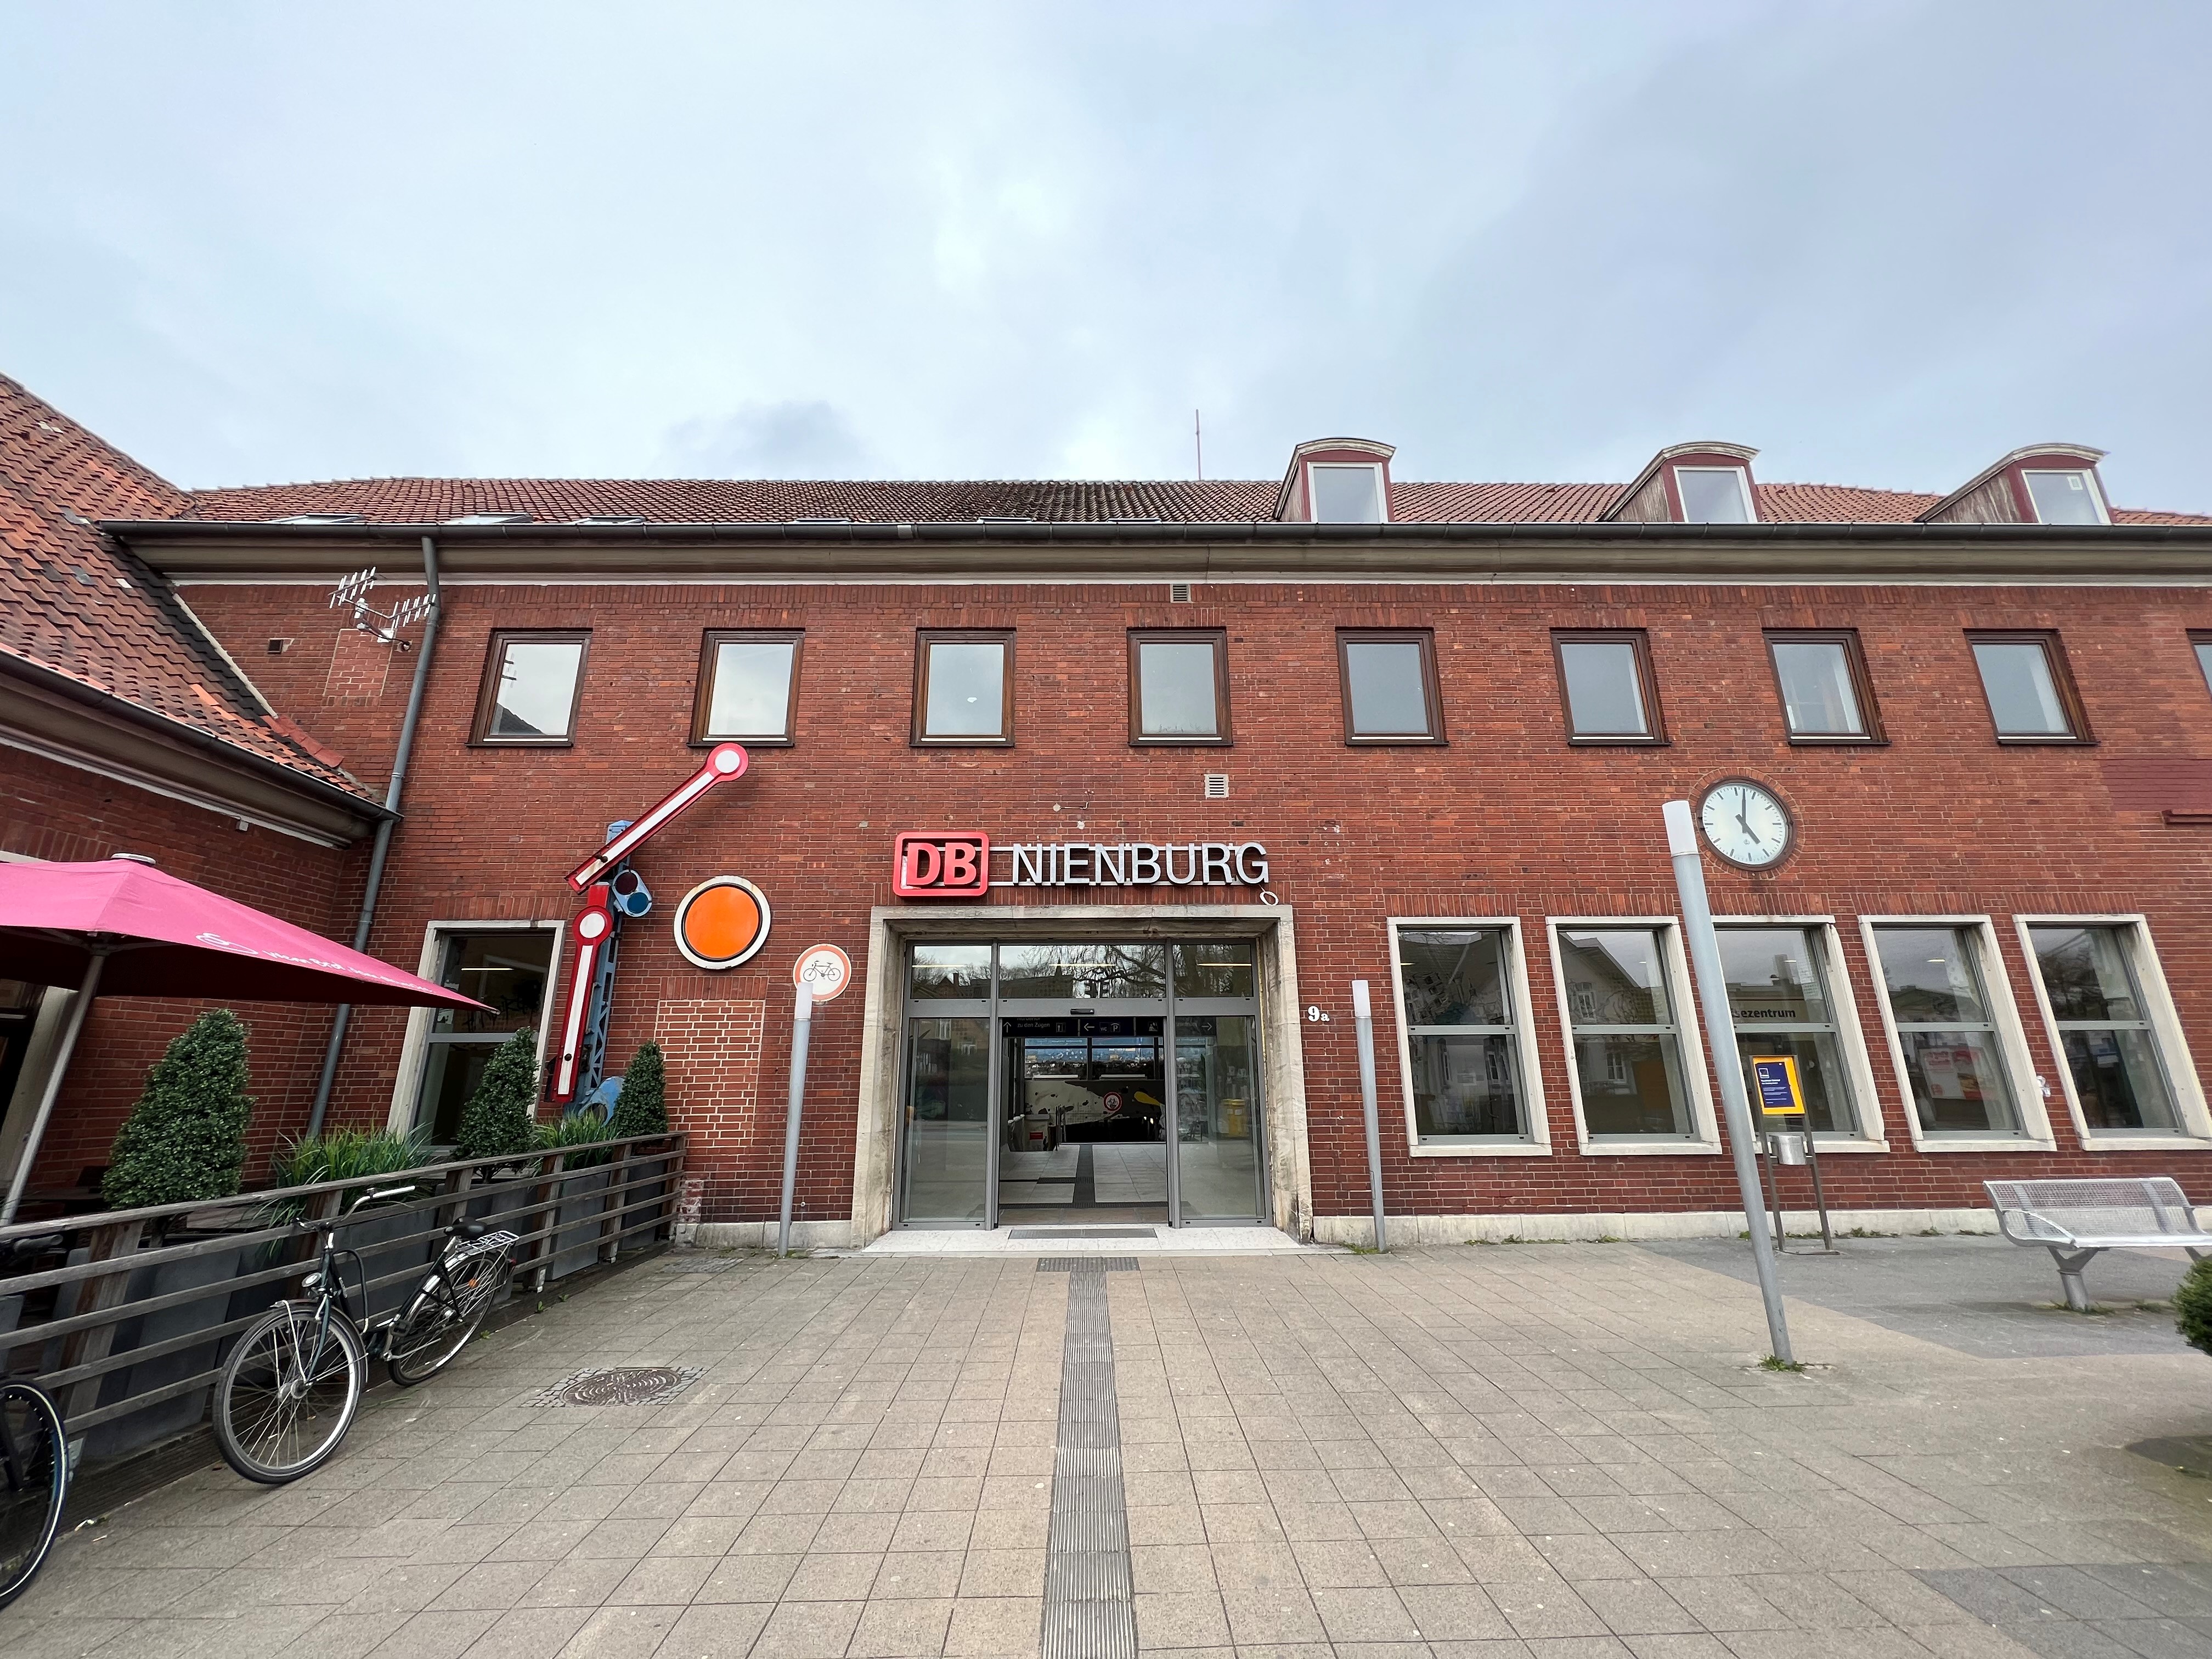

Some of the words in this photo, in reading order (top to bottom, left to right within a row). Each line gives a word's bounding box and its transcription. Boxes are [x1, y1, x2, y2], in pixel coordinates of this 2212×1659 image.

[907, 842, 977, 885] DB
[1012, 842, 1269, 885] NIENBURG
[1307, 1005, 1330, 1022] 9a
